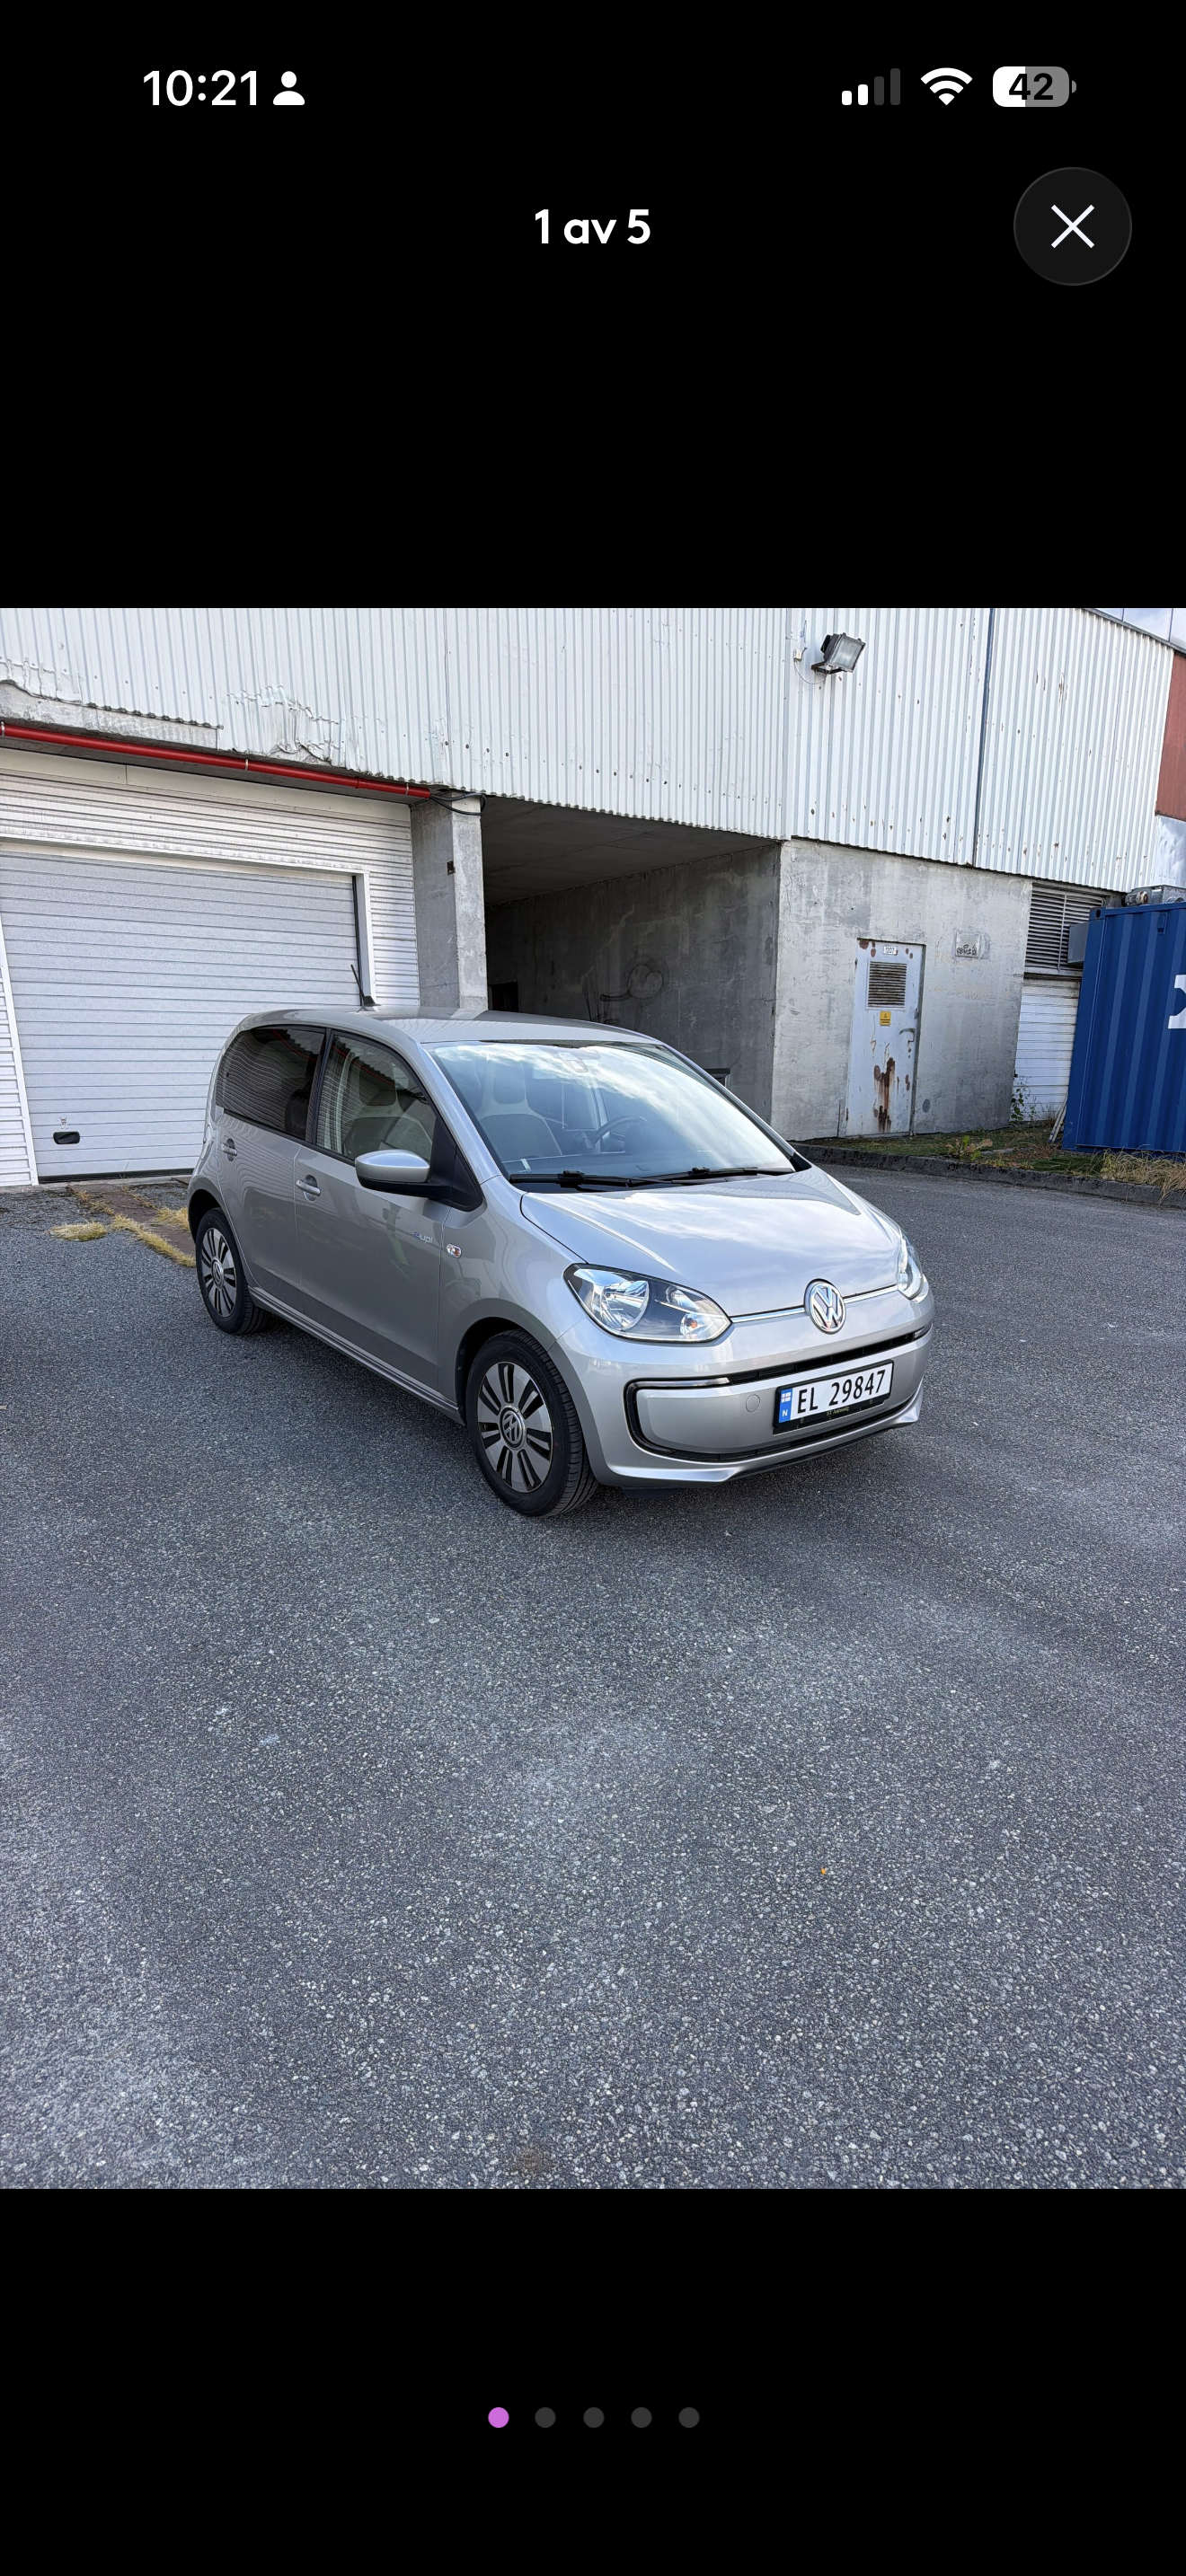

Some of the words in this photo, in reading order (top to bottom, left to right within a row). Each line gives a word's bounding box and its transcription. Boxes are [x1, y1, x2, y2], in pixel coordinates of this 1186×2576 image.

[797, 1387, 819, 1414] EL
[828, 1369, 886, 1407] 29847
[782, 1408, 789, 1417] N
